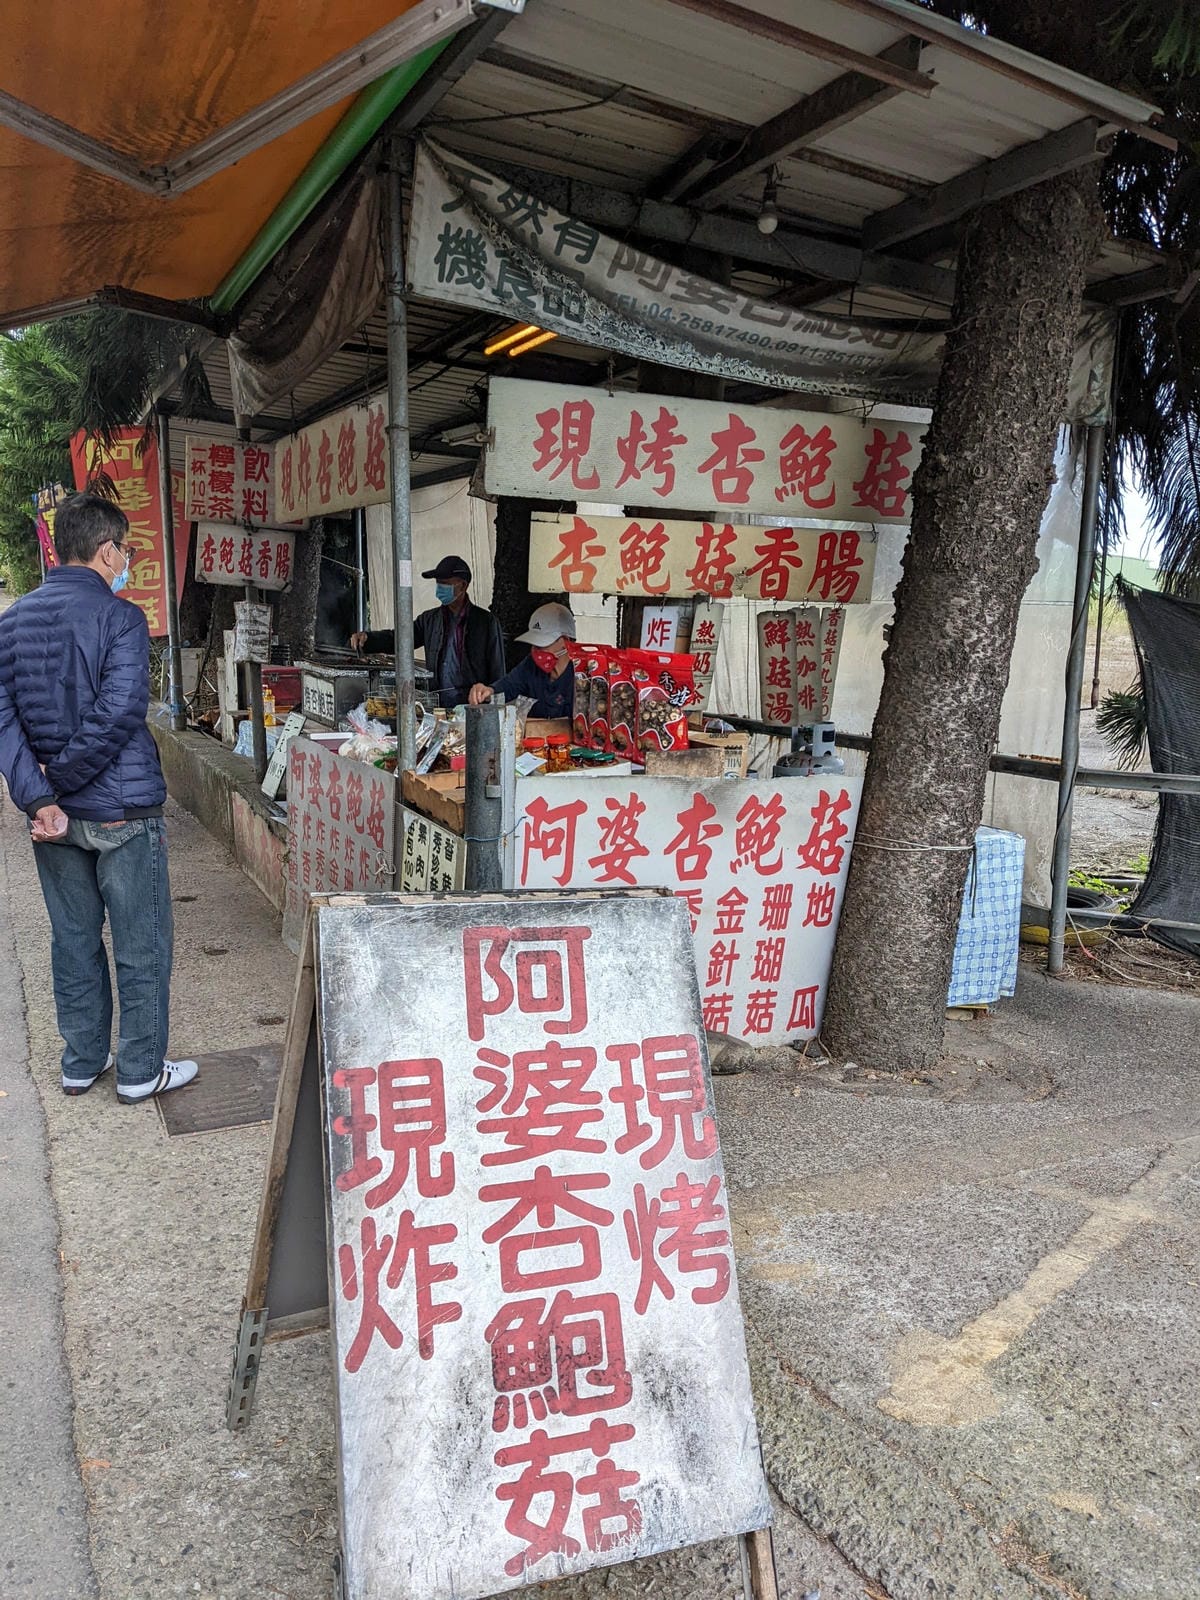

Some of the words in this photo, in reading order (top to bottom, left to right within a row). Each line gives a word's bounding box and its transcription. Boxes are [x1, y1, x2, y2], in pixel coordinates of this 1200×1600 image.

[191, 446, 207, 516] 一杯10元
[207, 443, 236, 520] 檸檬茶
[242, 447, 270, 523] 飲料
[532, 399, 914, 517] 現烤杏鮑菇
[200, 533, 290, 580] 杏鮑菇香腸
[547, 517, 864, 603] 杏鮑菇香腸
[646, 618, 672, 647] 炸
[763, 619, 794, 725] 鮮菇湯
[290, 744, 386, 849] 阿婆杏鮑菇
[520, 788, 853, 887] 阿婆杏鮑菇
[743, 883, 794, 1036] 珊瑚菇
[786, 882, 836, 1032] 地瓜
[332, 1057, 463, 1374] 現炸
[604, 1033, 731, 1317] 現烤
[462, 924, 642, 1578] 阿婆杏鮑菇
